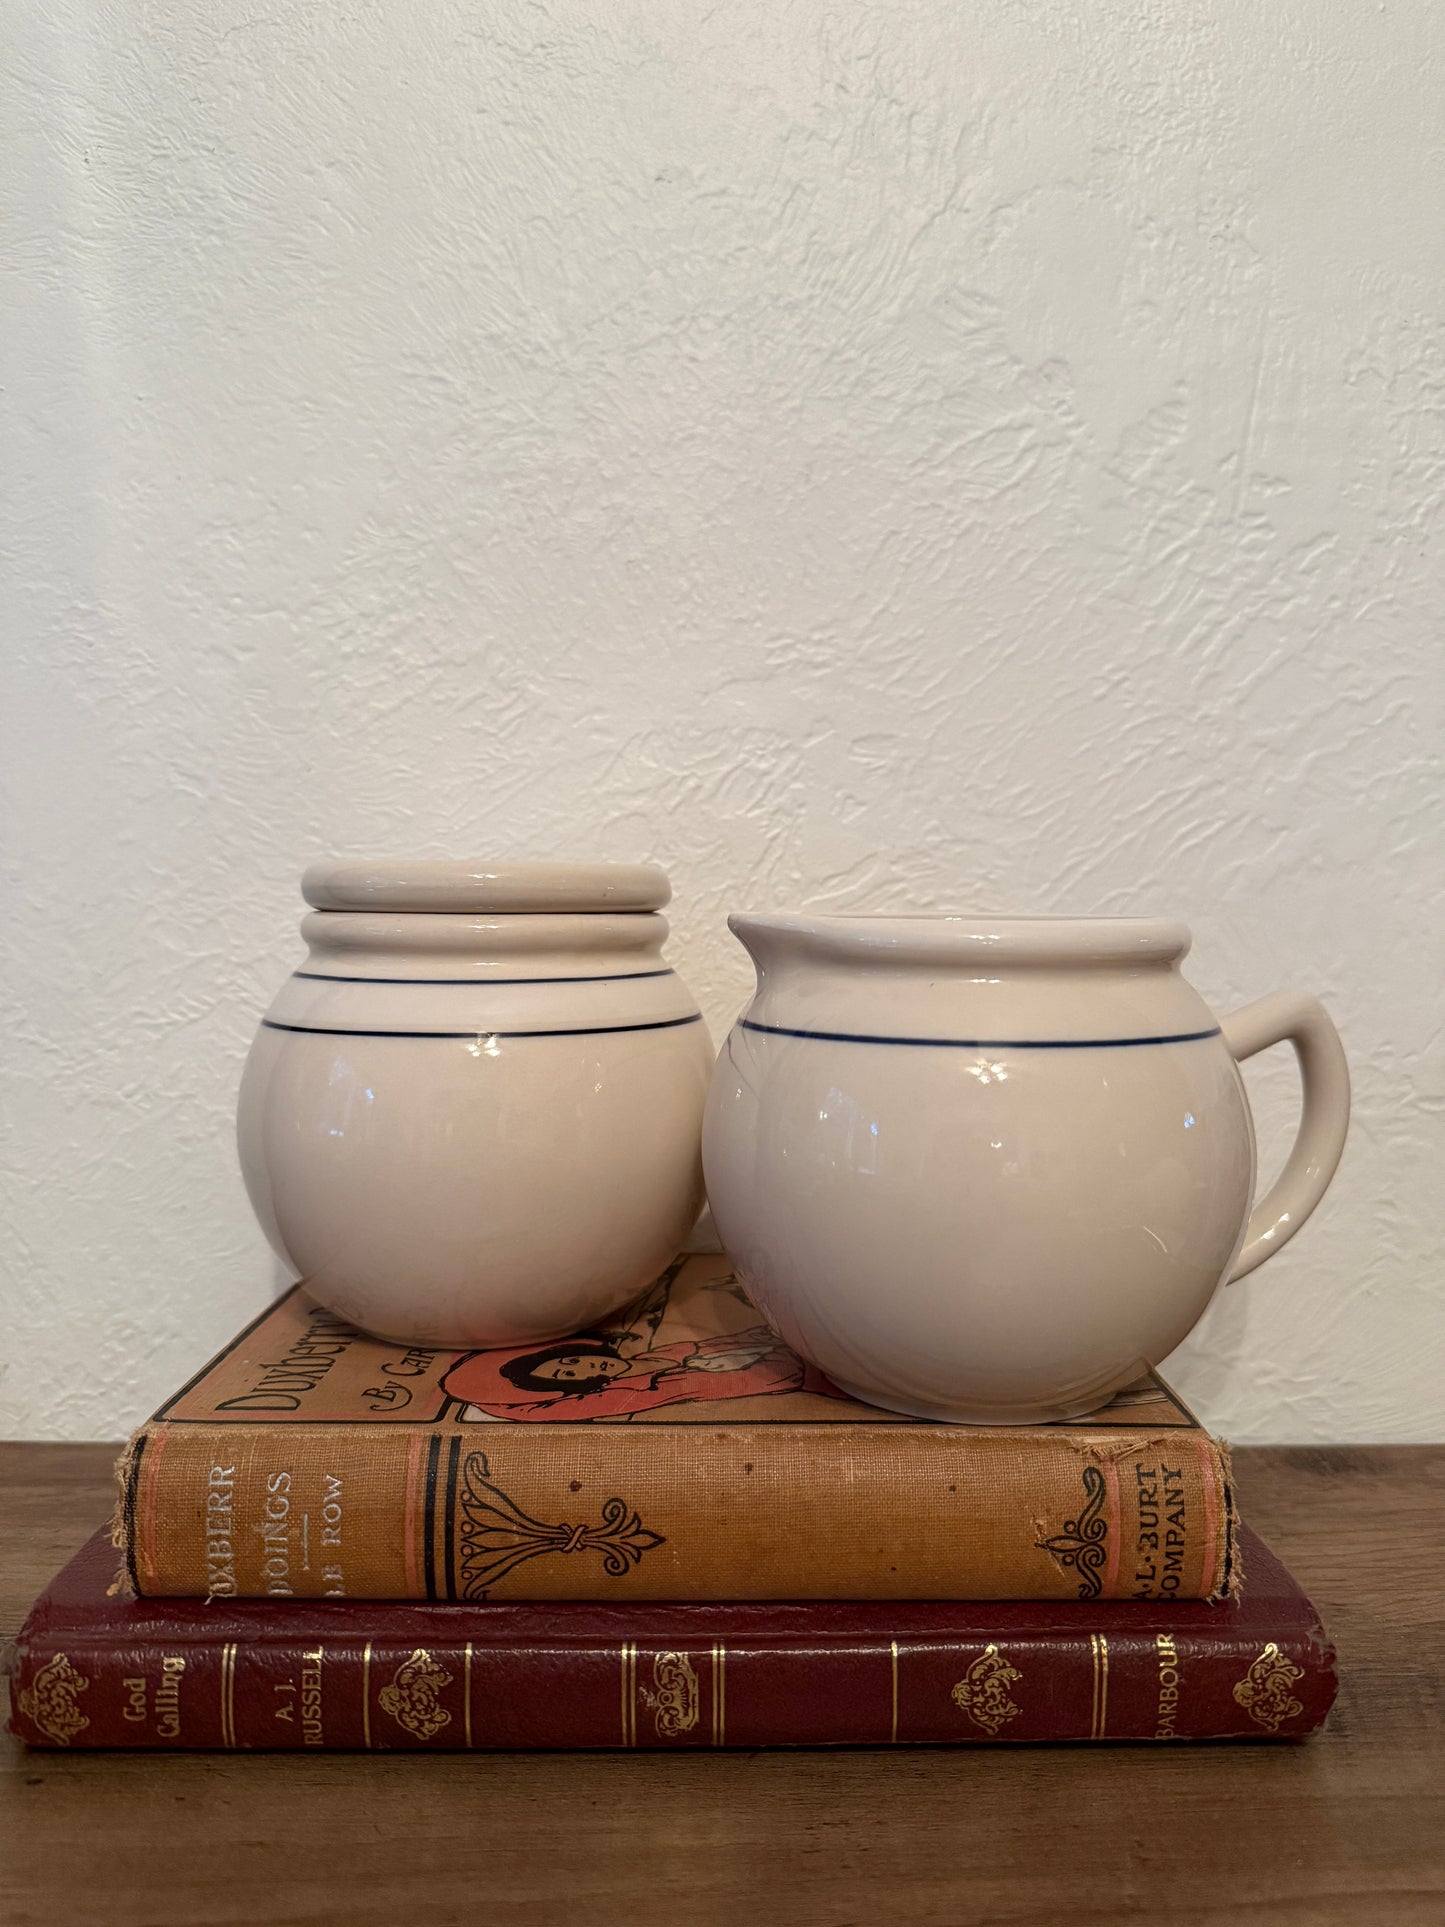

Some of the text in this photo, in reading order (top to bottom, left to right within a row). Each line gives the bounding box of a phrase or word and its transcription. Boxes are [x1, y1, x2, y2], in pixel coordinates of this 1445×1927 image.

[361, 1380, 413, 1412] By
[321, 1474, 344, 1546] ROW
[123, 1678, 147, 1722] God
[156, 1656, 186, 1738] Calling
[302, 1645, 324, 1745] RUSSELL
[1155, 1632, 1179, 1740] BARBOUR
